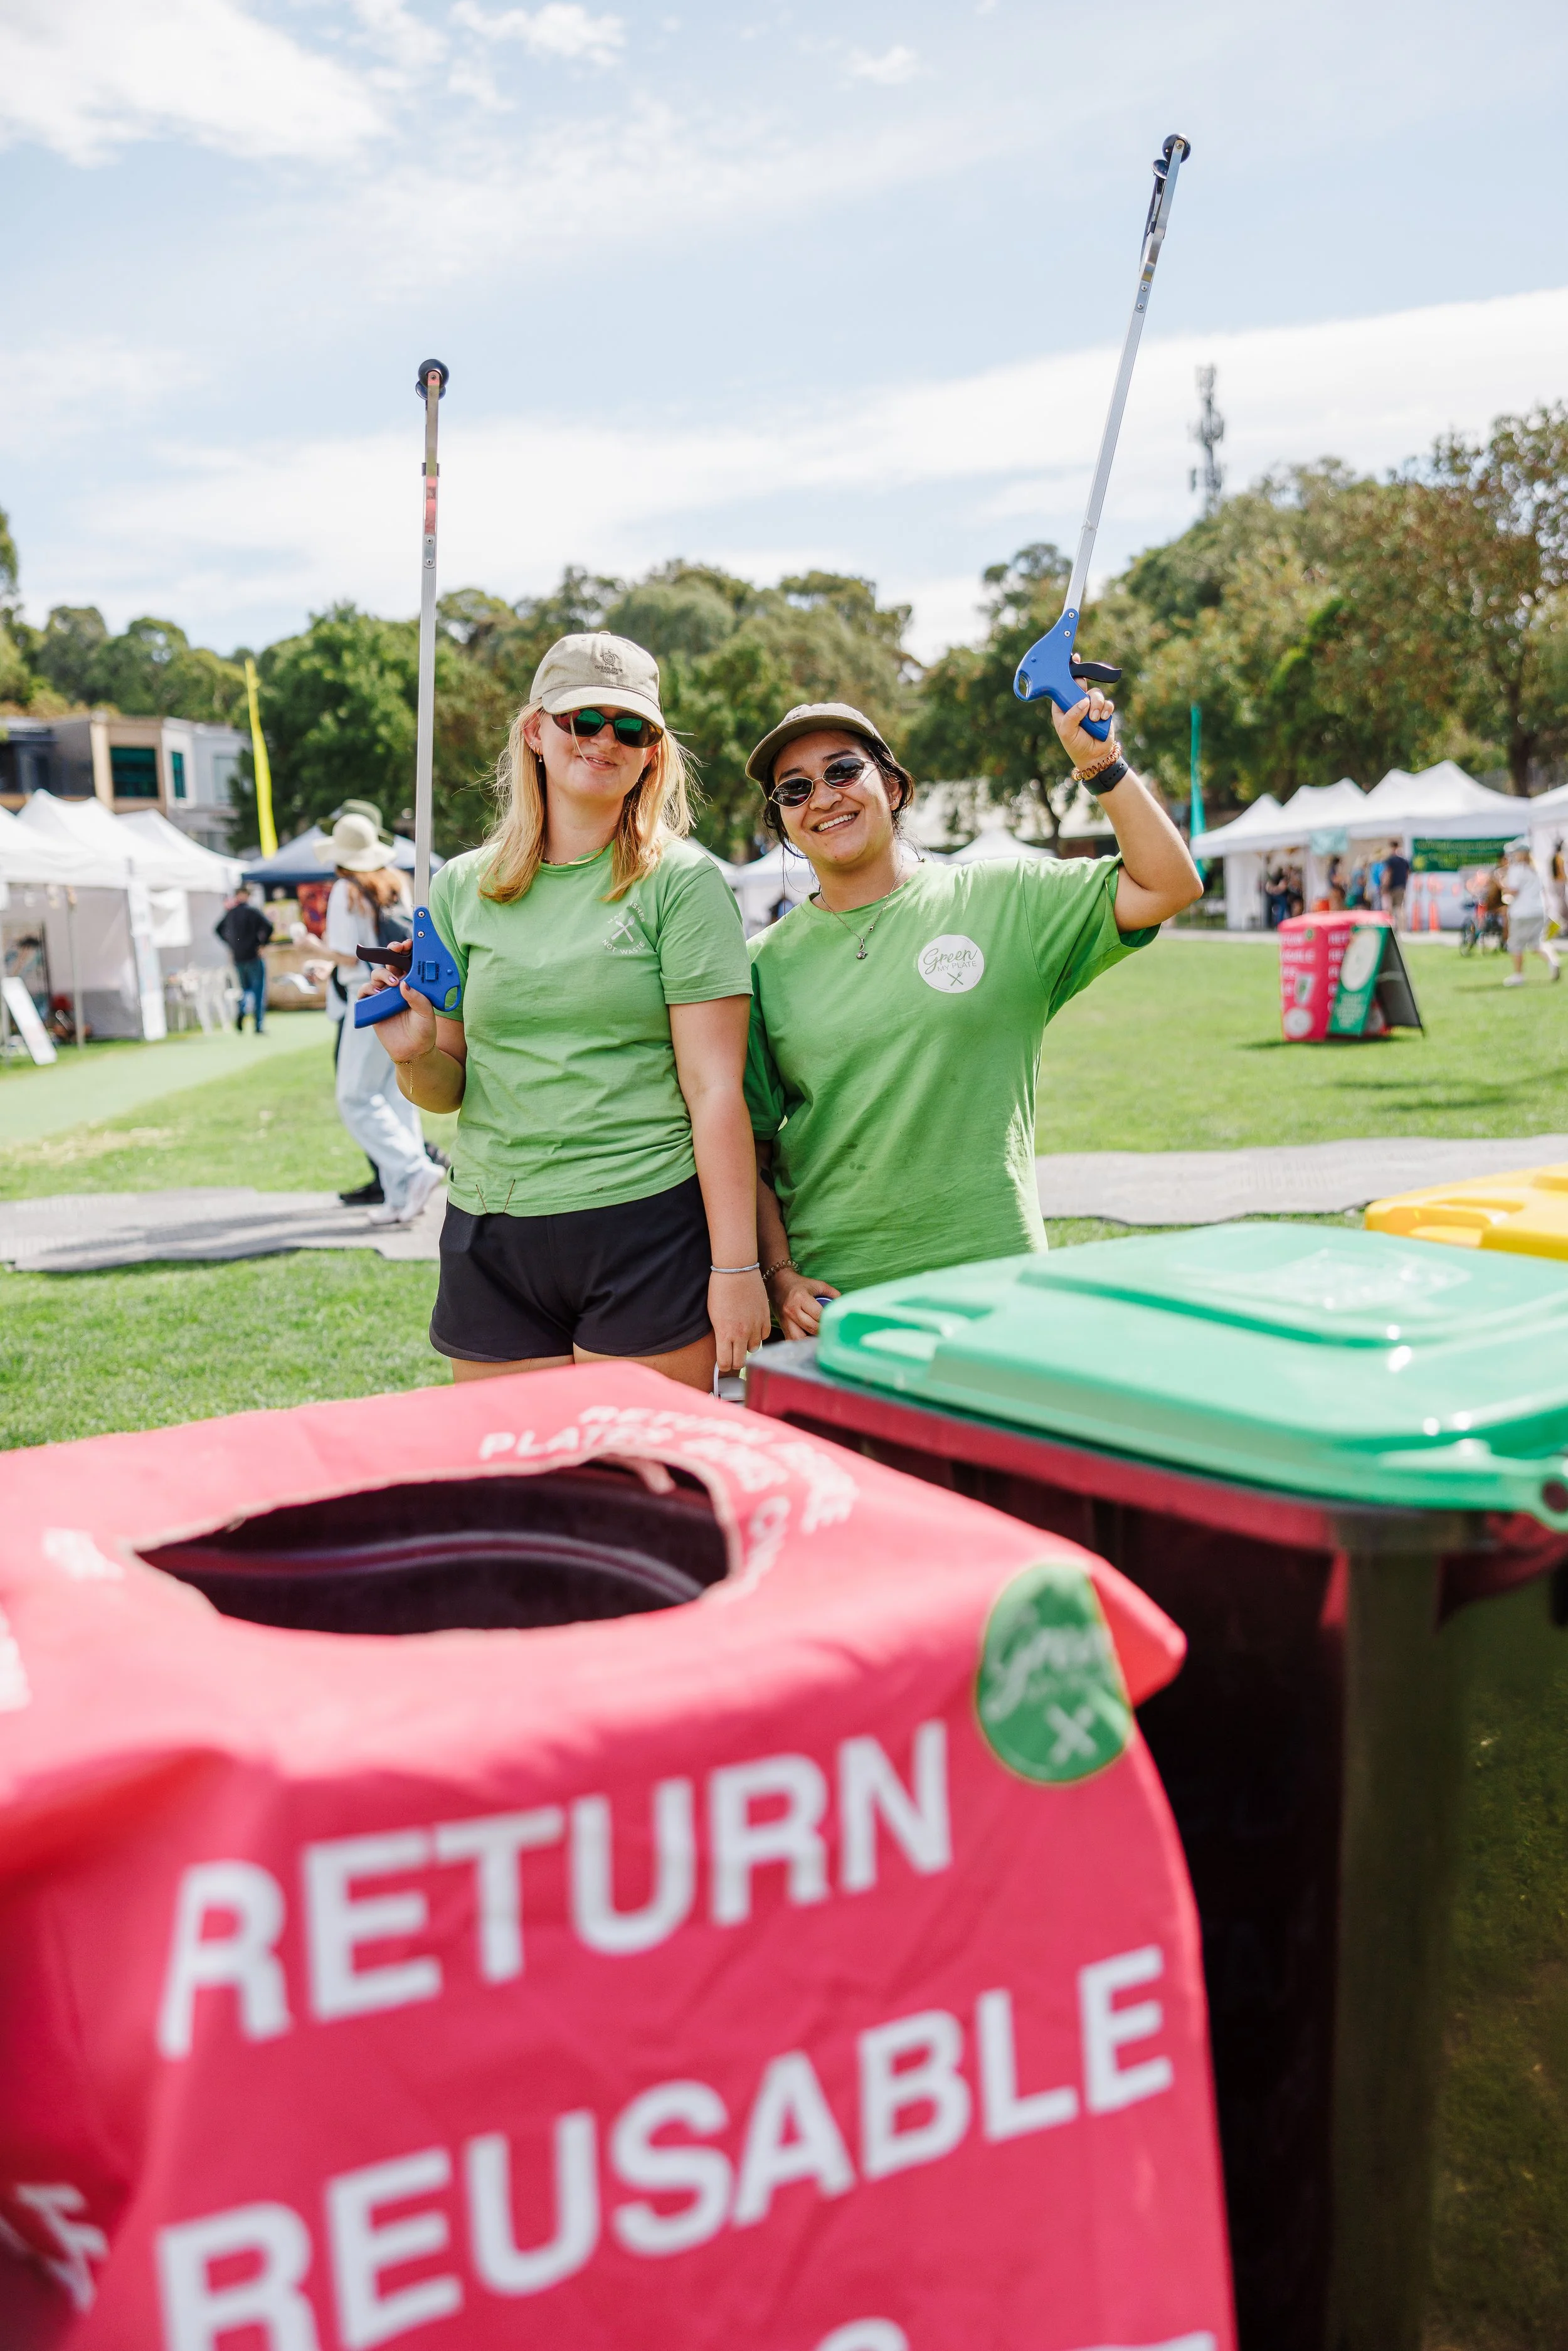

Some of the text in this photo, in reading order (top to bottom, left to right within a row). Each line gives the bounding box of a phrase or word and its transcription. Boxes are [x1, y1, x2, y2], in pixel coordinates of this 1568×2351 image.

[601, 938, 645, 955] NOT WASTE
[923, 948, 978, 975] Green
[478, 1426, 675, 1460] PLATES
[156, 1719, 954, 2060] RETURN
[154, 1943, 1176, 2351] REUSABLE
